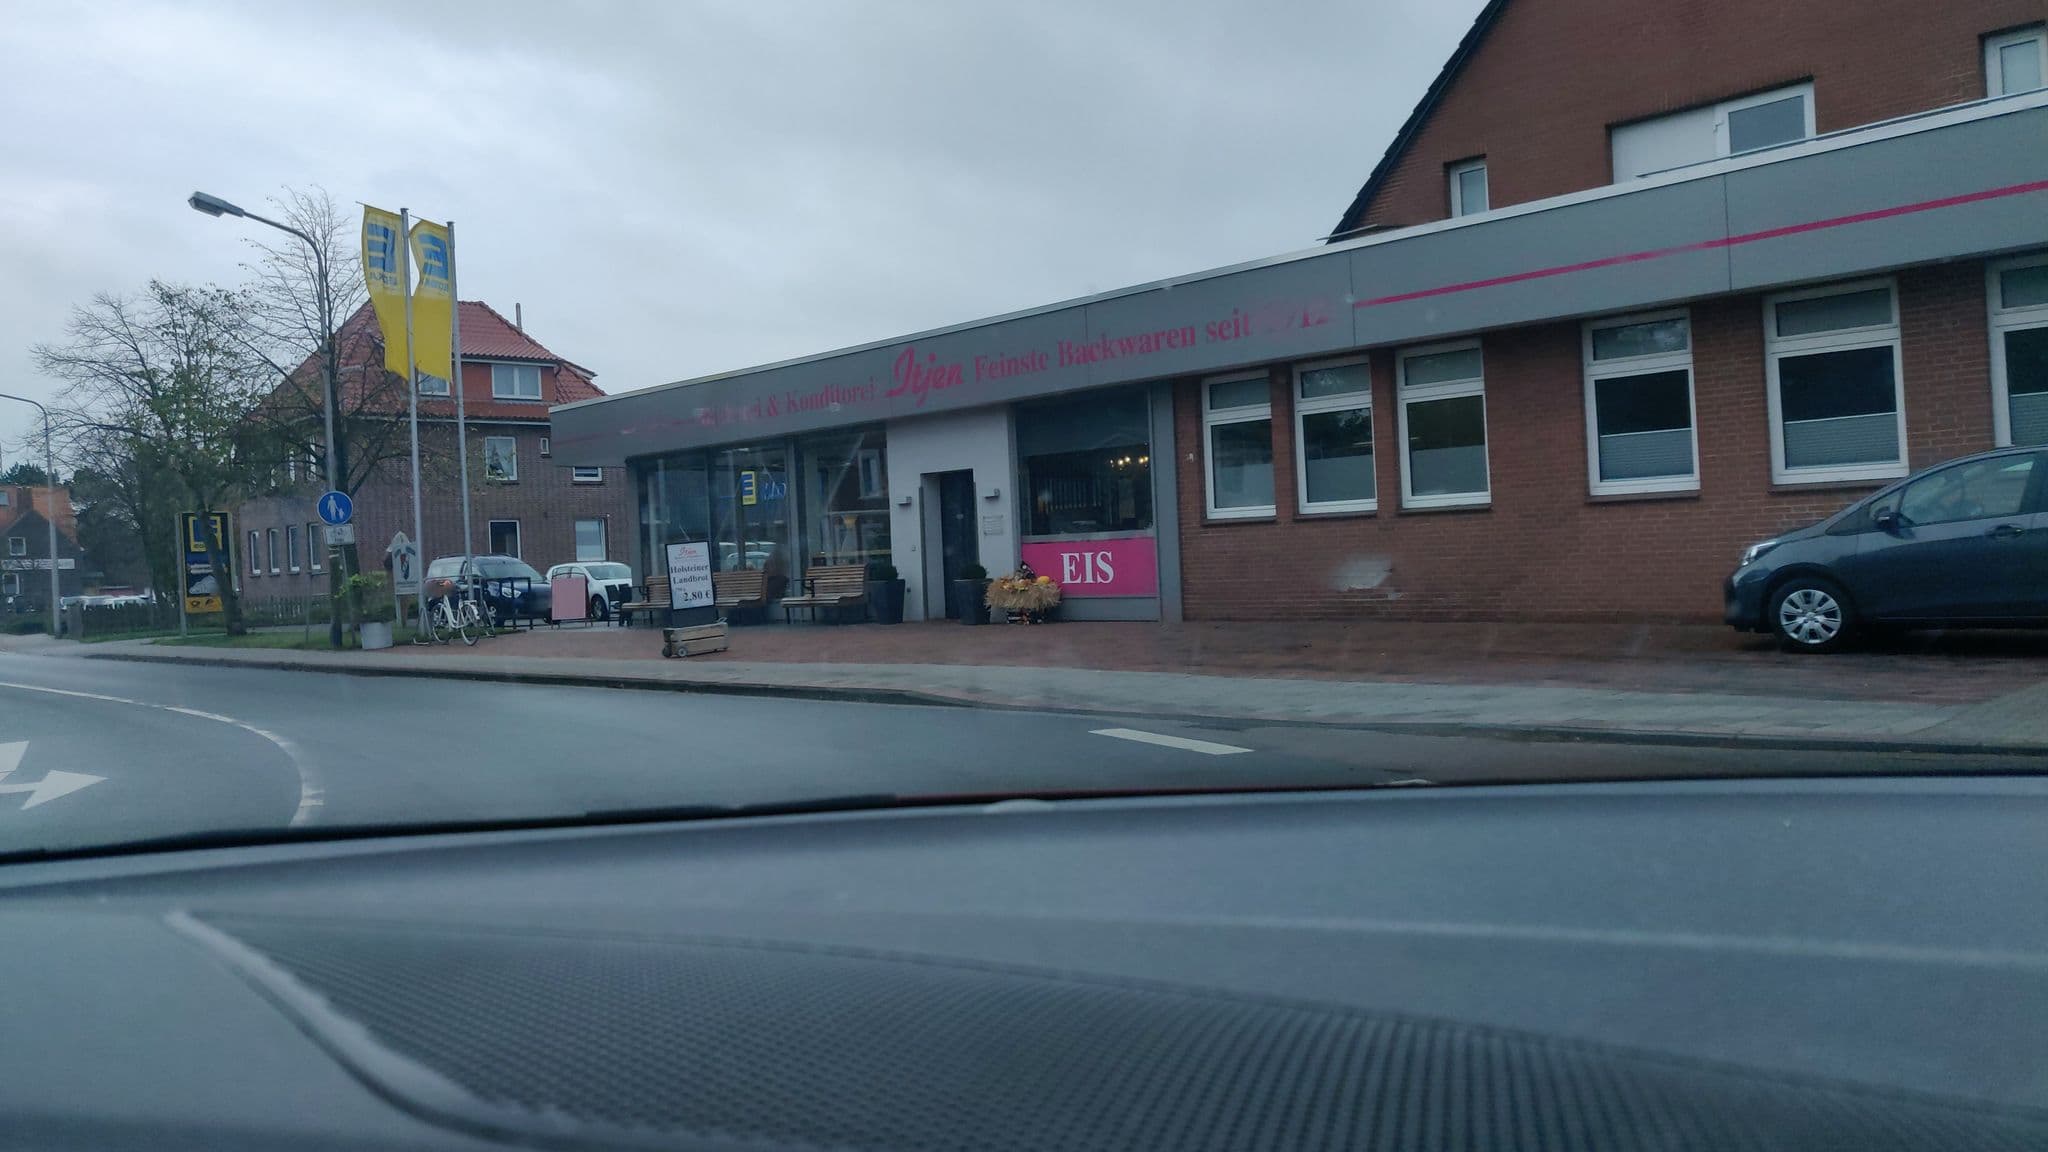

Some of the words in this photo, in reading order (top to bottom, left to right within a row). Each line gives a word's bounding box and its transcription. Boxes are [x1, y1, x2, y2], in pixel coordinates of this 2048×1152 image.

[975, 350, 1049, 383] Feinste
[1058, 324, 1196, 369] Backwaren
[1206, 306, 1255, 344] seit
[670, 564, 709, 574] Holsteiner
[1060, 551, 1114, 584] EIS
[673, 575, 708, 585] Landbrot
[705, 590, 711, 598] €
